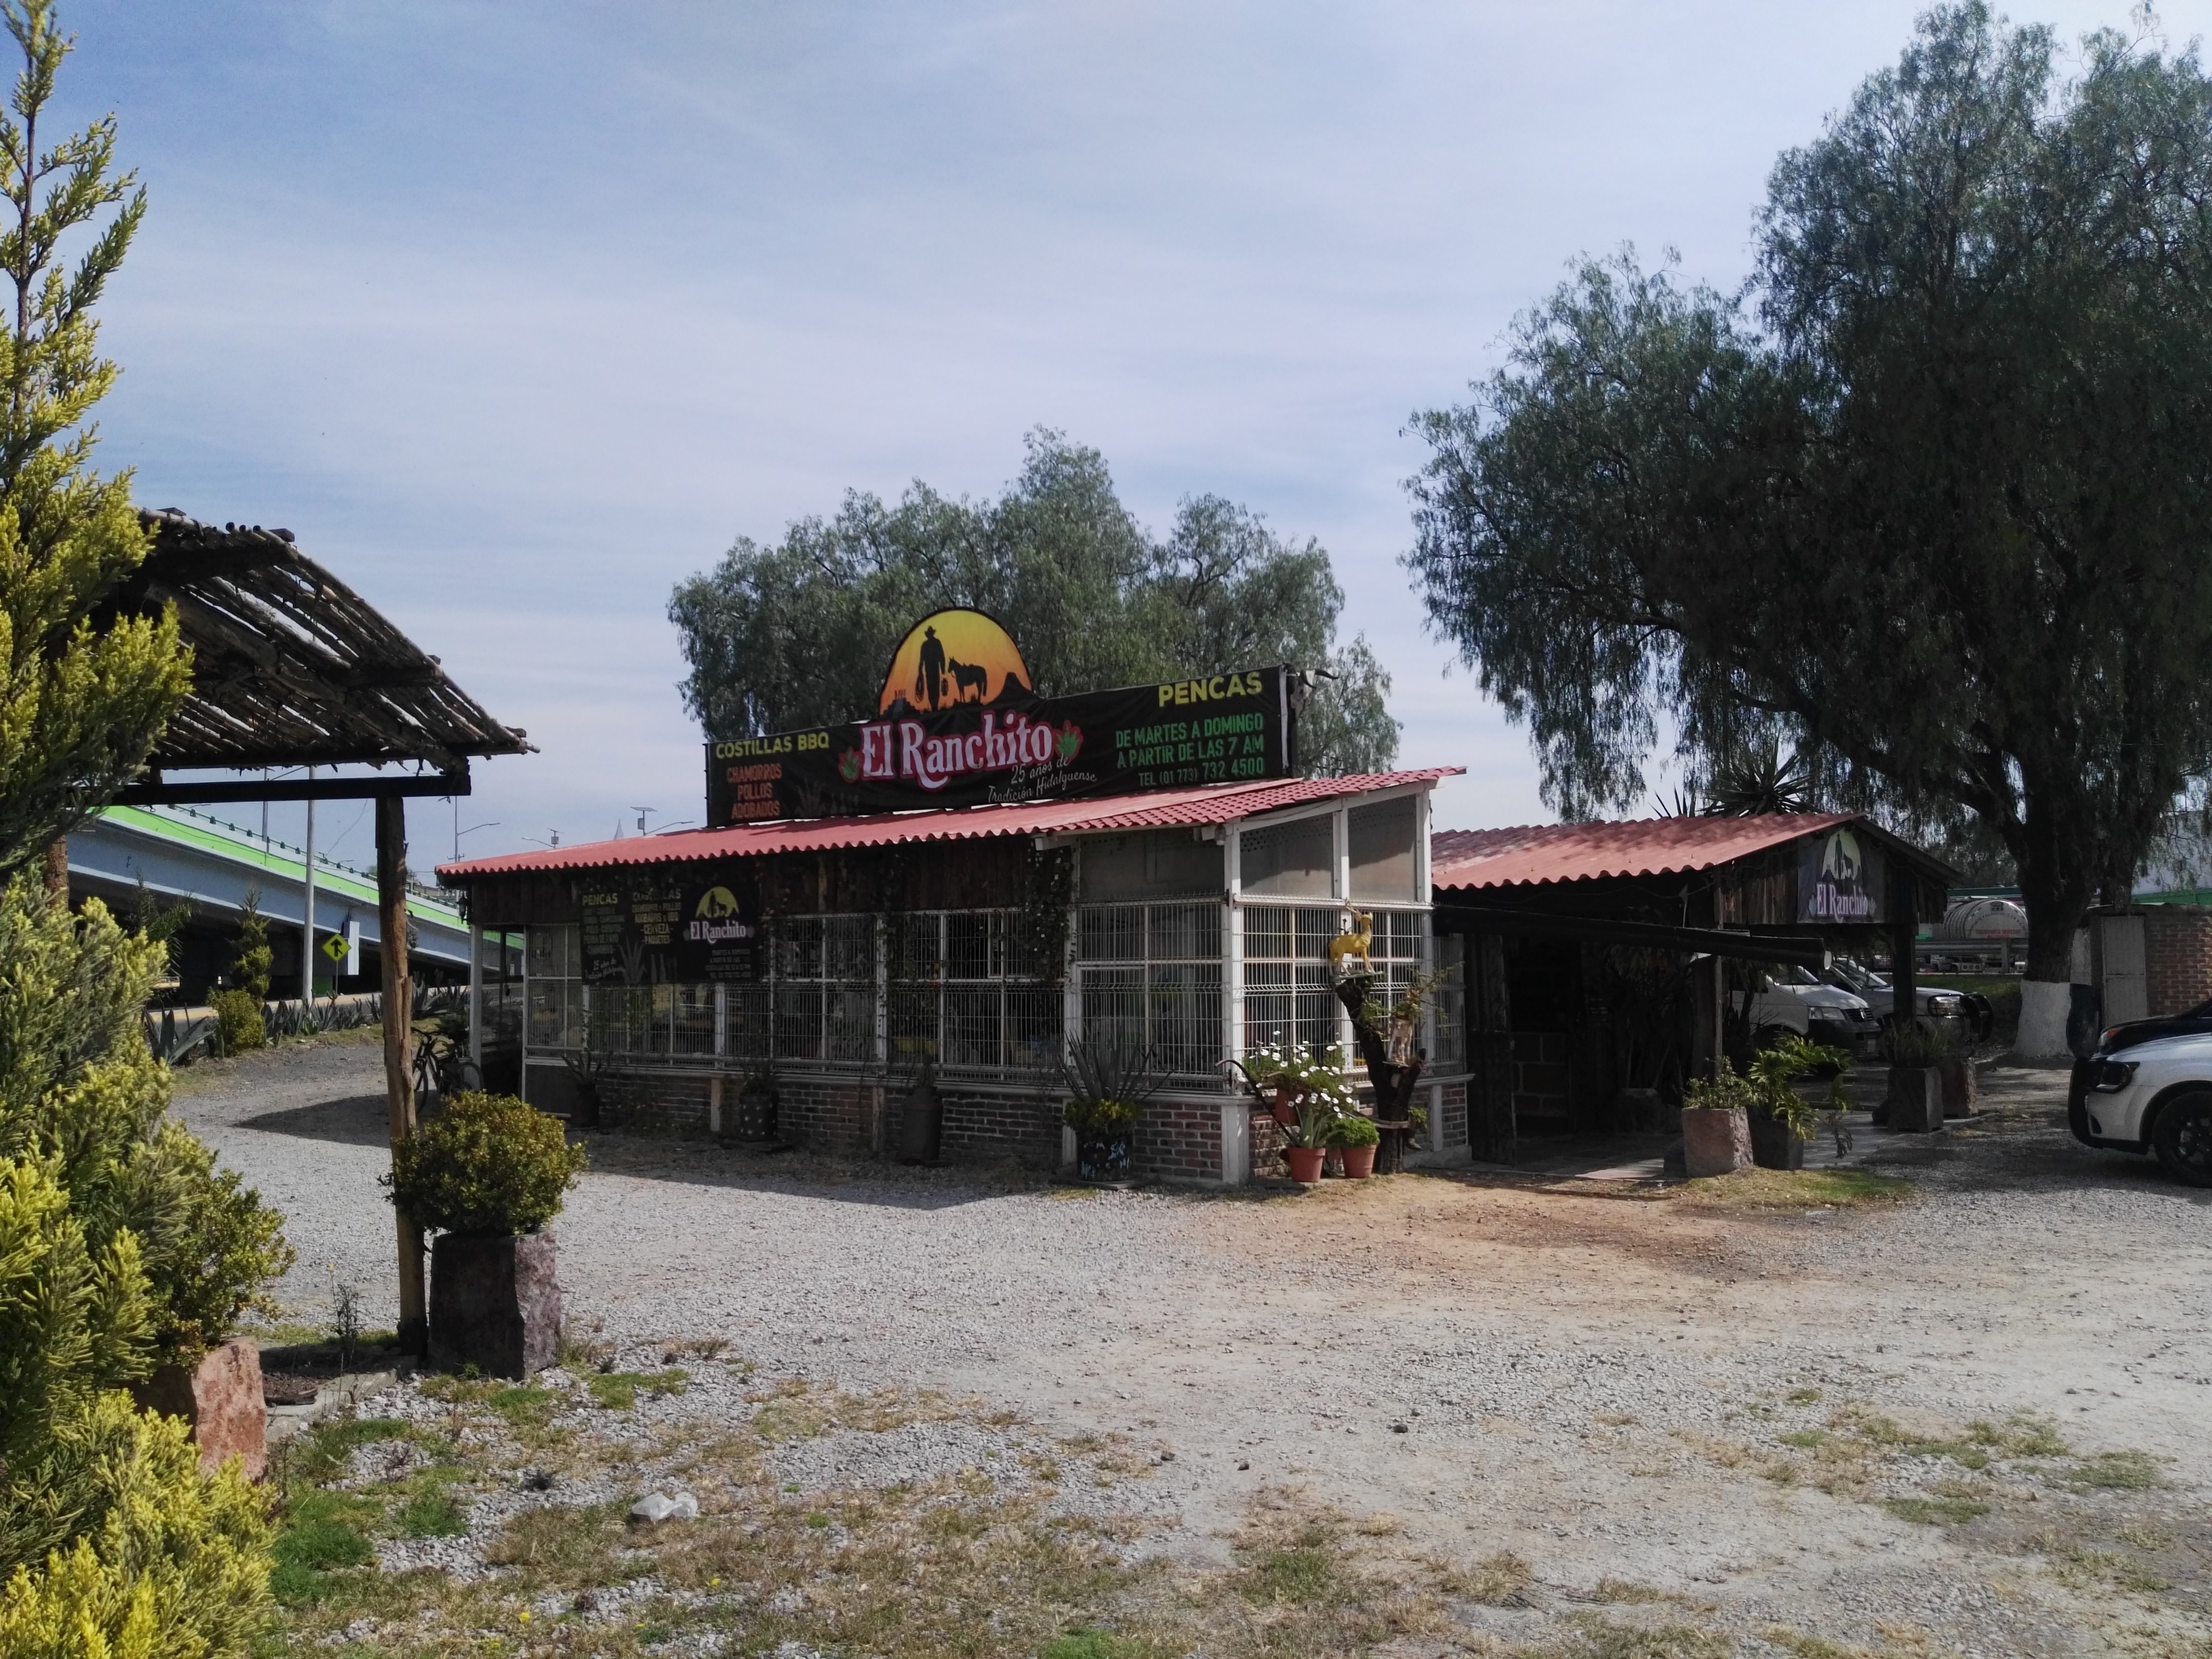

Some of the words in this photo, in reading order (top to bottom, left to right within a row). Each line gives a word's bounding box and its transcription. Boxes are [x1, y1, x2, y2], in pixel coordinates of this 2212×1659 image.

[1159, 671, 1262, 707] PENCAS
[1116, 730, 1131, 748] DE
[1134, 722, 1187, 745] MARTES
[1191, 720, 1200, 739] A
[1204, 712, 1264, 736] DOMINGO
[716, 735, 793, 759] COSTILLAS
[797, 732, 830, 751] BBQ
[862, 725, 894, 777] El
[900, 714, 1052, 789] Ranchito
[1117, 751, 1127, 768] A
[1129, 745, 1174, 767] PARTIR
[1178, 742, 1194, 761] DE
[1198, 739, 1224, 759] LAS
[1228, 737, 1238, 755] 7
[1243, 734, 1264, 754] AM
[727, 763, 782, 783] CHAMORROS
[1011, 763, 1025, 784] 25
[1029, 761, 1052, 778] años
[1056, 753, 1069, 767] de
[1138, 772, 1157, 787] TEL
[1202, 761, 1226, 780] 732
[1231, 757, 1264, 776] 4500
[737, 782, 773, 801] POLLOS
[988, 785, 1034, 803] Tradición
[1036, 770, 1097, 797] Hidalguense
[731, 800, 781, 819] ADOBADOS
[582, 892, 618, 906] PENCAS
[1816, 884, 1827, 914] El
[1829, 883, 1868, 923] Ranchito
[690, 921, 700, 939] El
[702, 919, 746, 944] Ranchito
